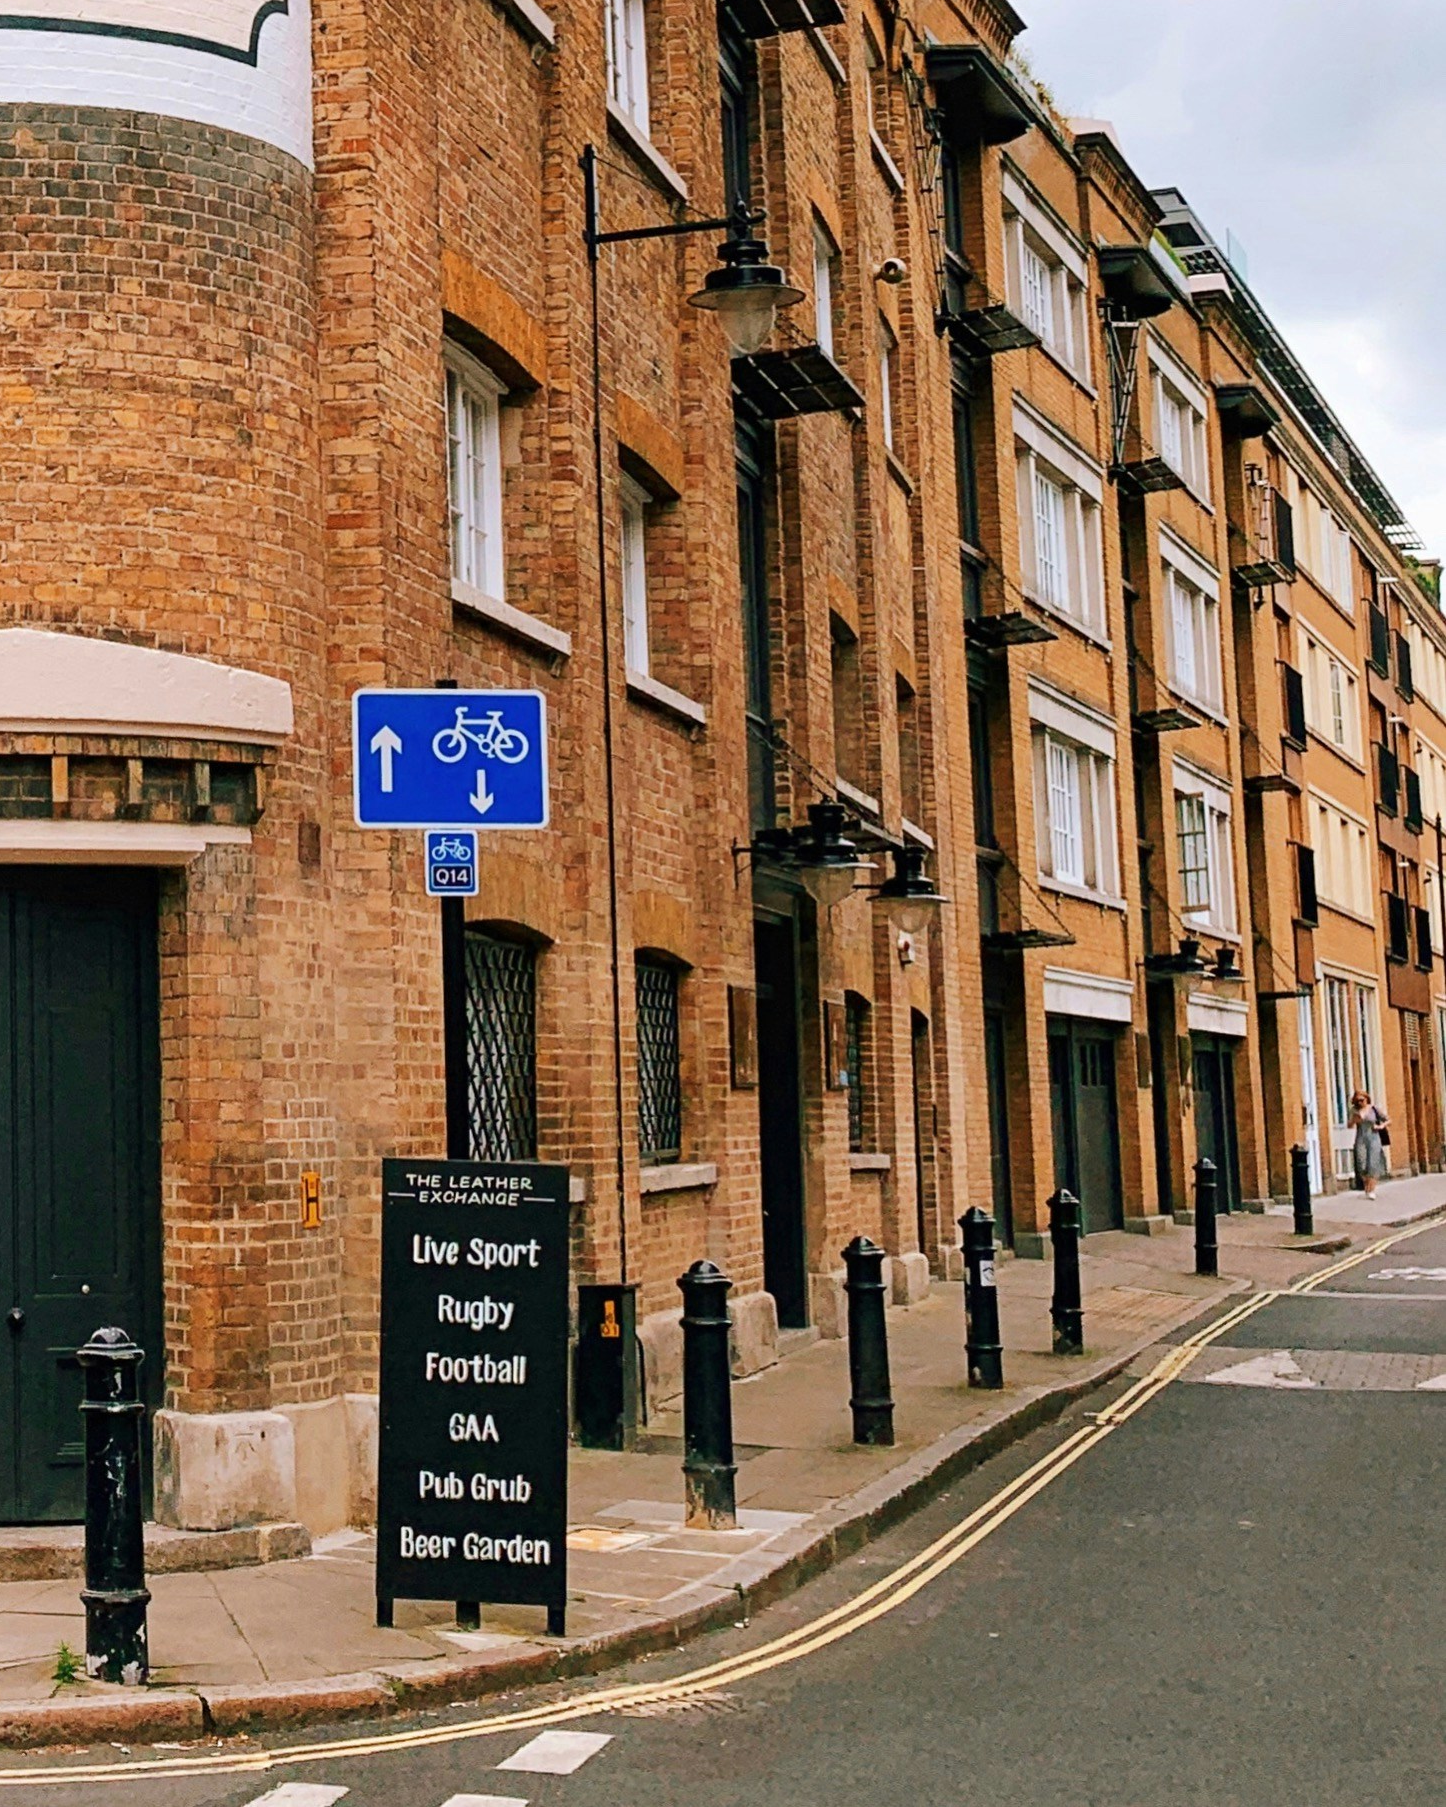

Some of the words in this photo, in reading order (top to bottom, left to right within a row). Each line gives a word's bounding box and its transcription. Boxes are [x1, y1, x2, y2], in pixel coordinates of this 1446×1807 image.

[436, 868, 468, 885] Q14
[406, 1174, 440, 1188] THE
[449, 1175, 533, 1191] LEATHER
[419, 1191, 520, 1207] EXCHANGE
[412, 1234, 459, 1265] Live
[467, 1238, 541, 1269] Sport
[438, 1294, 514, 1331] Rugby
[425, 1352, 527, 1385] Football
[449, 1413, 500, 1442] GAA
[419, 1471, 464, 1500] Pub
[471, 1472, 531, 1503] Grub
[400, 1526, 456, 1559] Beer
[463, 1531, 551, 1565] Garden
